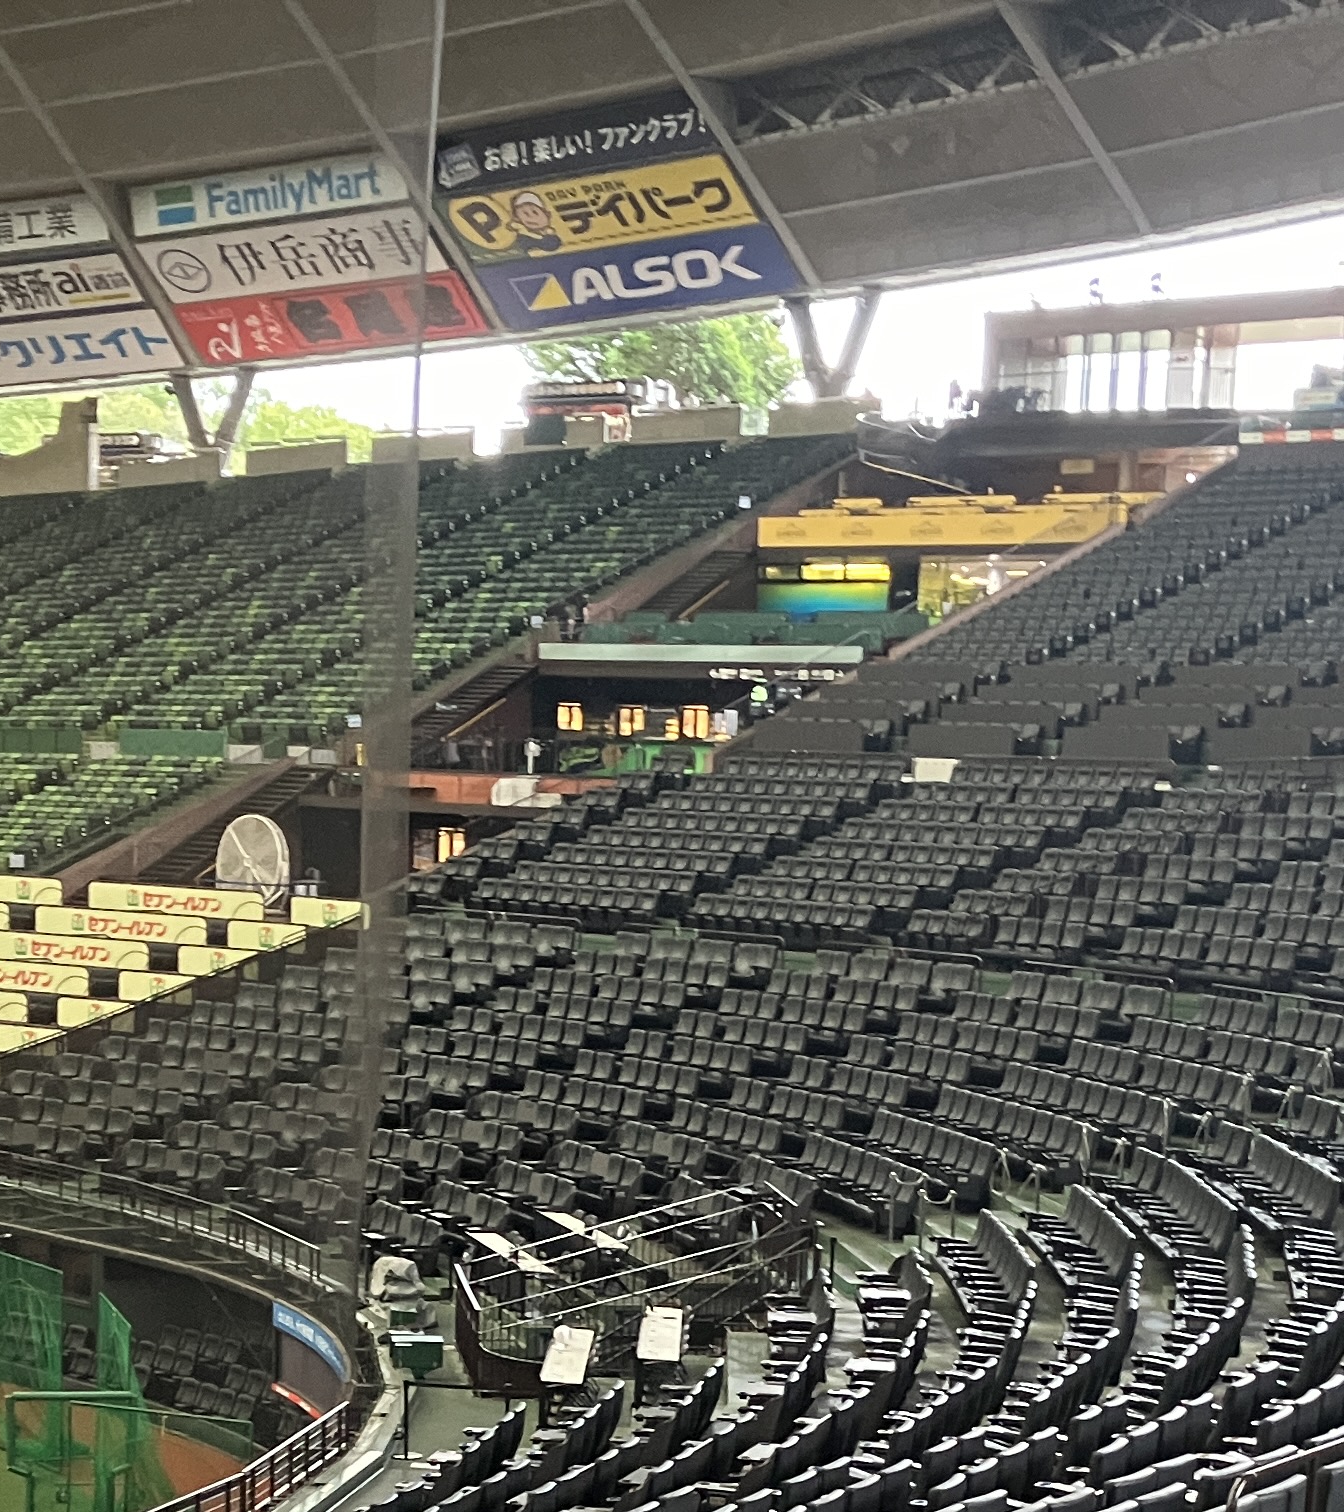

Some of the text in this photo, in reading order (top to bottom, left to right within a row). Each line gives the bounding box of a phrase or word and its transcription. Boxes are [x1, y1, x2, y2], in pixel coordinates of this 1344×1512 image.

[206, 163, 381, 217] FamilyMart
[560, 178, 732, 235] デイパーク
[570, 245, 762, 305] ALSOK
